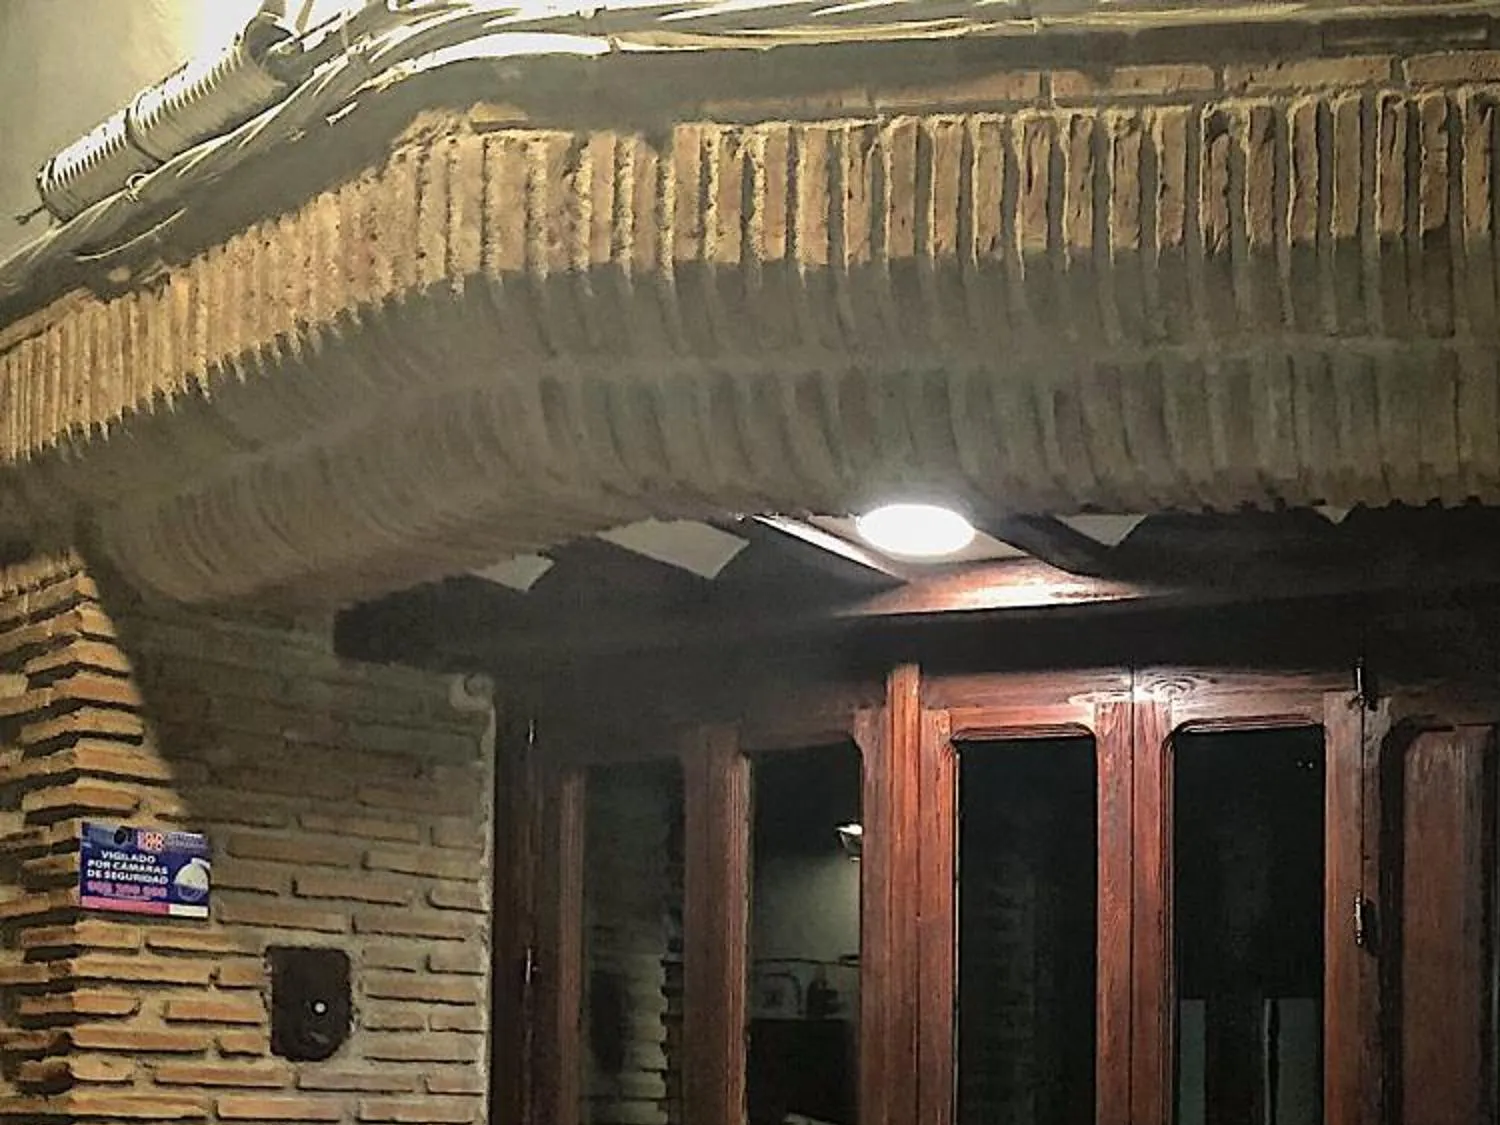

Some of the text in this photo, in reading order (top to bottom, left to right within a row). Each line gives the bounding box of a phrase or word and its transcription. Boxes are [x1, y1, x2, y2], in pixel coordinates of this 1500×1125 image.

[101, 850, 157, 864] VIGILADO
[87, 859, 112, 870] POR
[87, 869, 169, 886] DE SEGURIDAD
